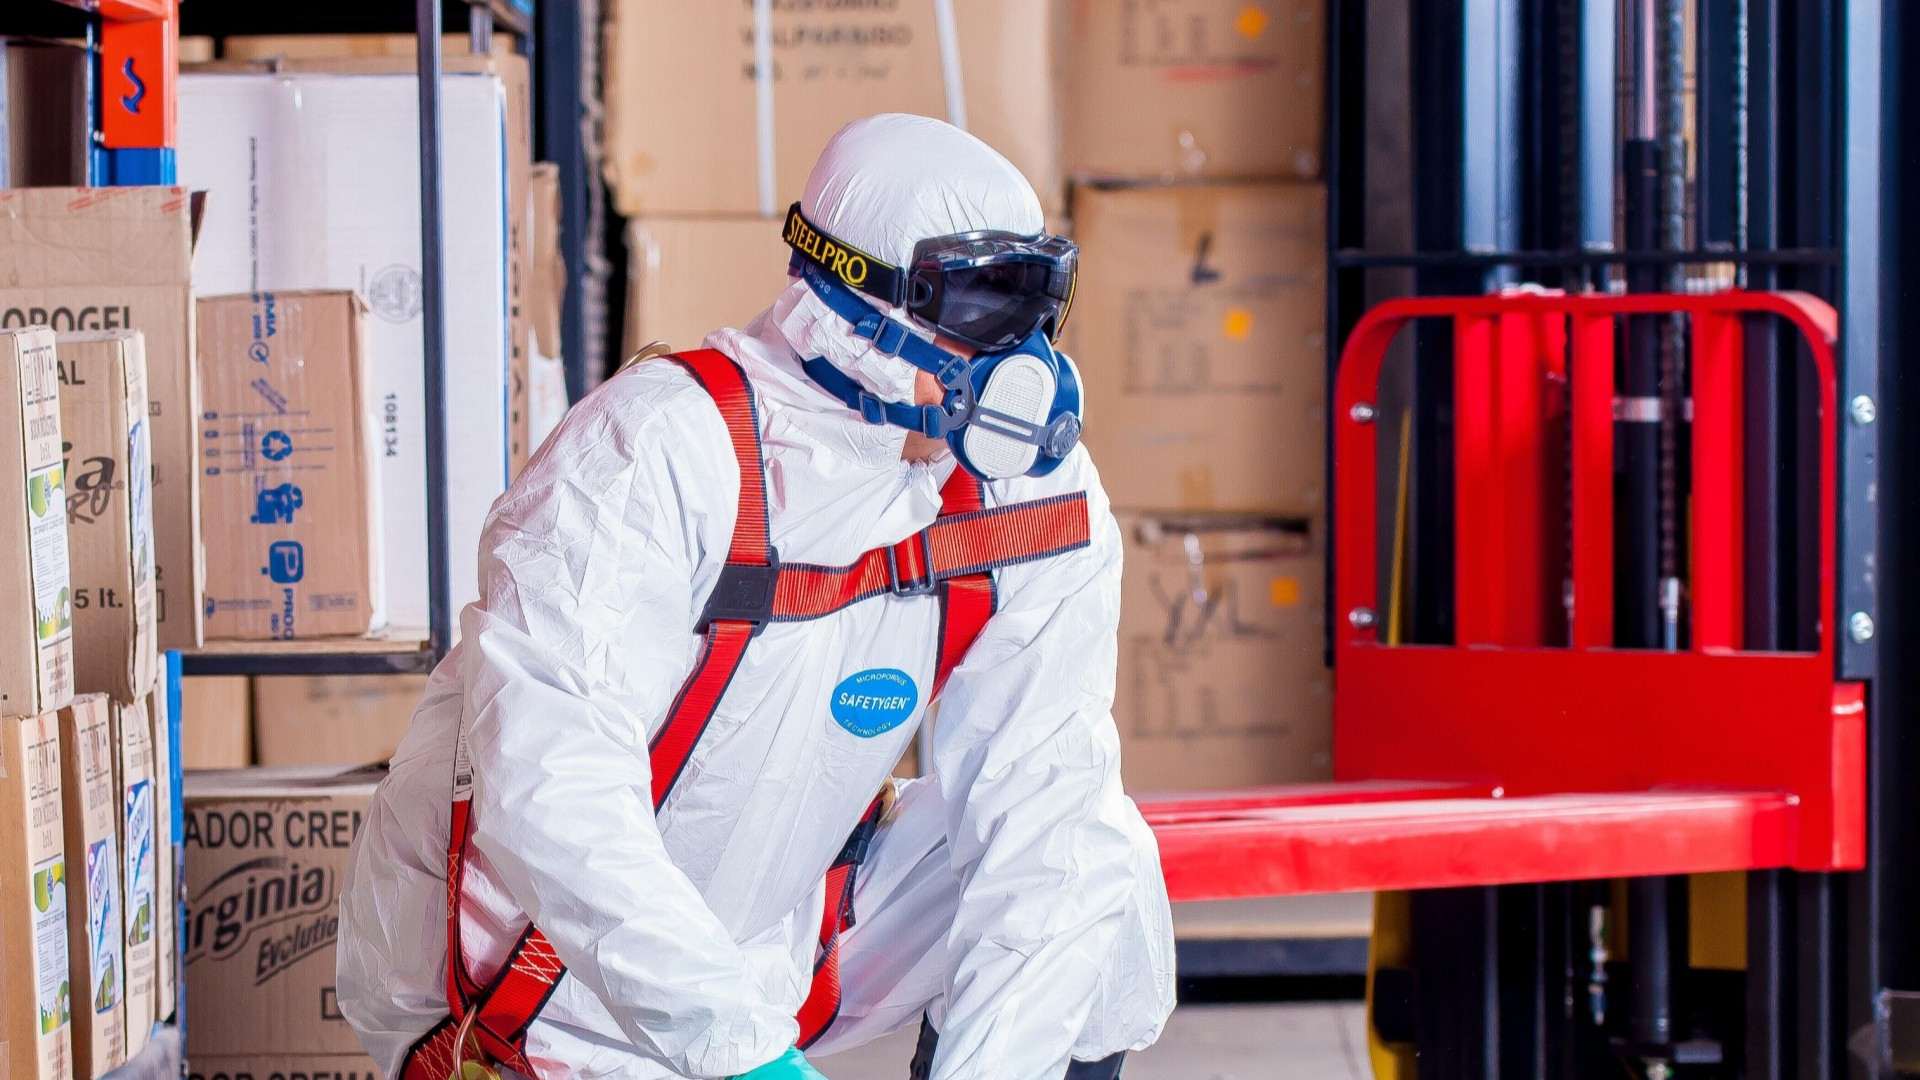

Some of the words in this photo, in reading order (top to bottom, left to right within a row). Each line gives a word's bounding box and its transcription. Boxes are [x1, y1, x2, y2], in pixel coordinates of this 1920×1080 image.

[787, 213, 867, 287] STEELPRO
[74, 588, 90, 610] 5
[99, 587, 124, 609] lt.
[856, 673, 907, 687] MICROPOROUS
[839, 692, 907, 711] SAFETYGEN
[843, 719, 892, 736] TECHNOLOGY
